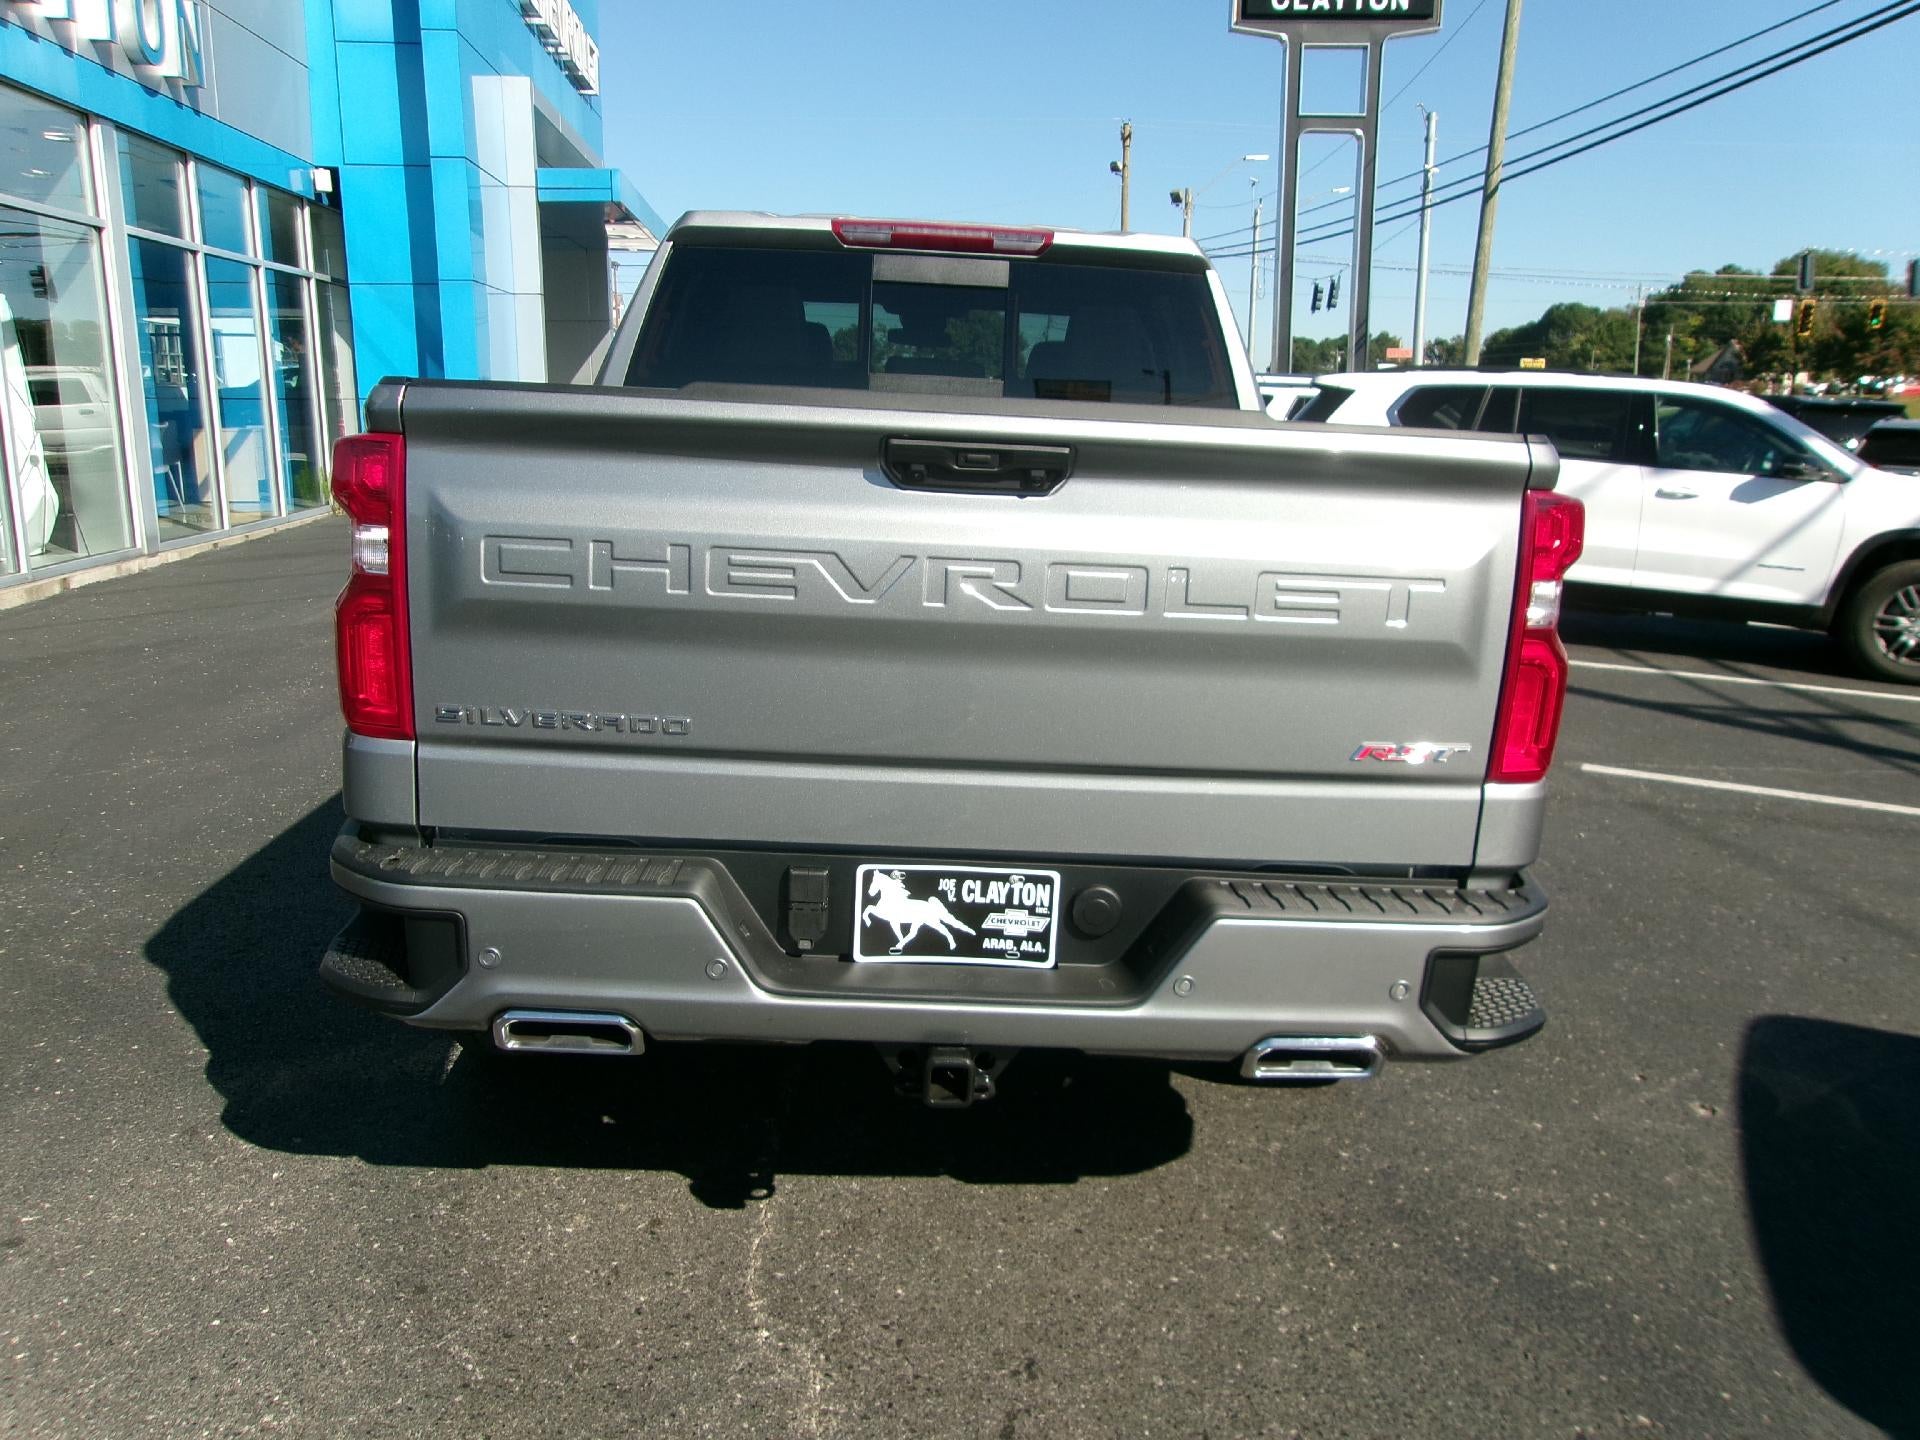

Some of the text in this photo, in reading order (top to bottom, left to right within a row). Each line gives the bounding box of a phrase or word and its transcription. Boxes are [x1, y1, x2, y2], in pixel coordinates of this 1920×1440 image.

[480, 534, 1446, 628] CHEVROLET
[434, 704, 692, 735] SILVERADO
[938, 879, 957, 891] JOE
[961, 880, 1051, 908] CLAYTON
[991, 917, 1041, 927] CHEVROLET
[982, 938, 1046, 953] ARAB, ALA.
